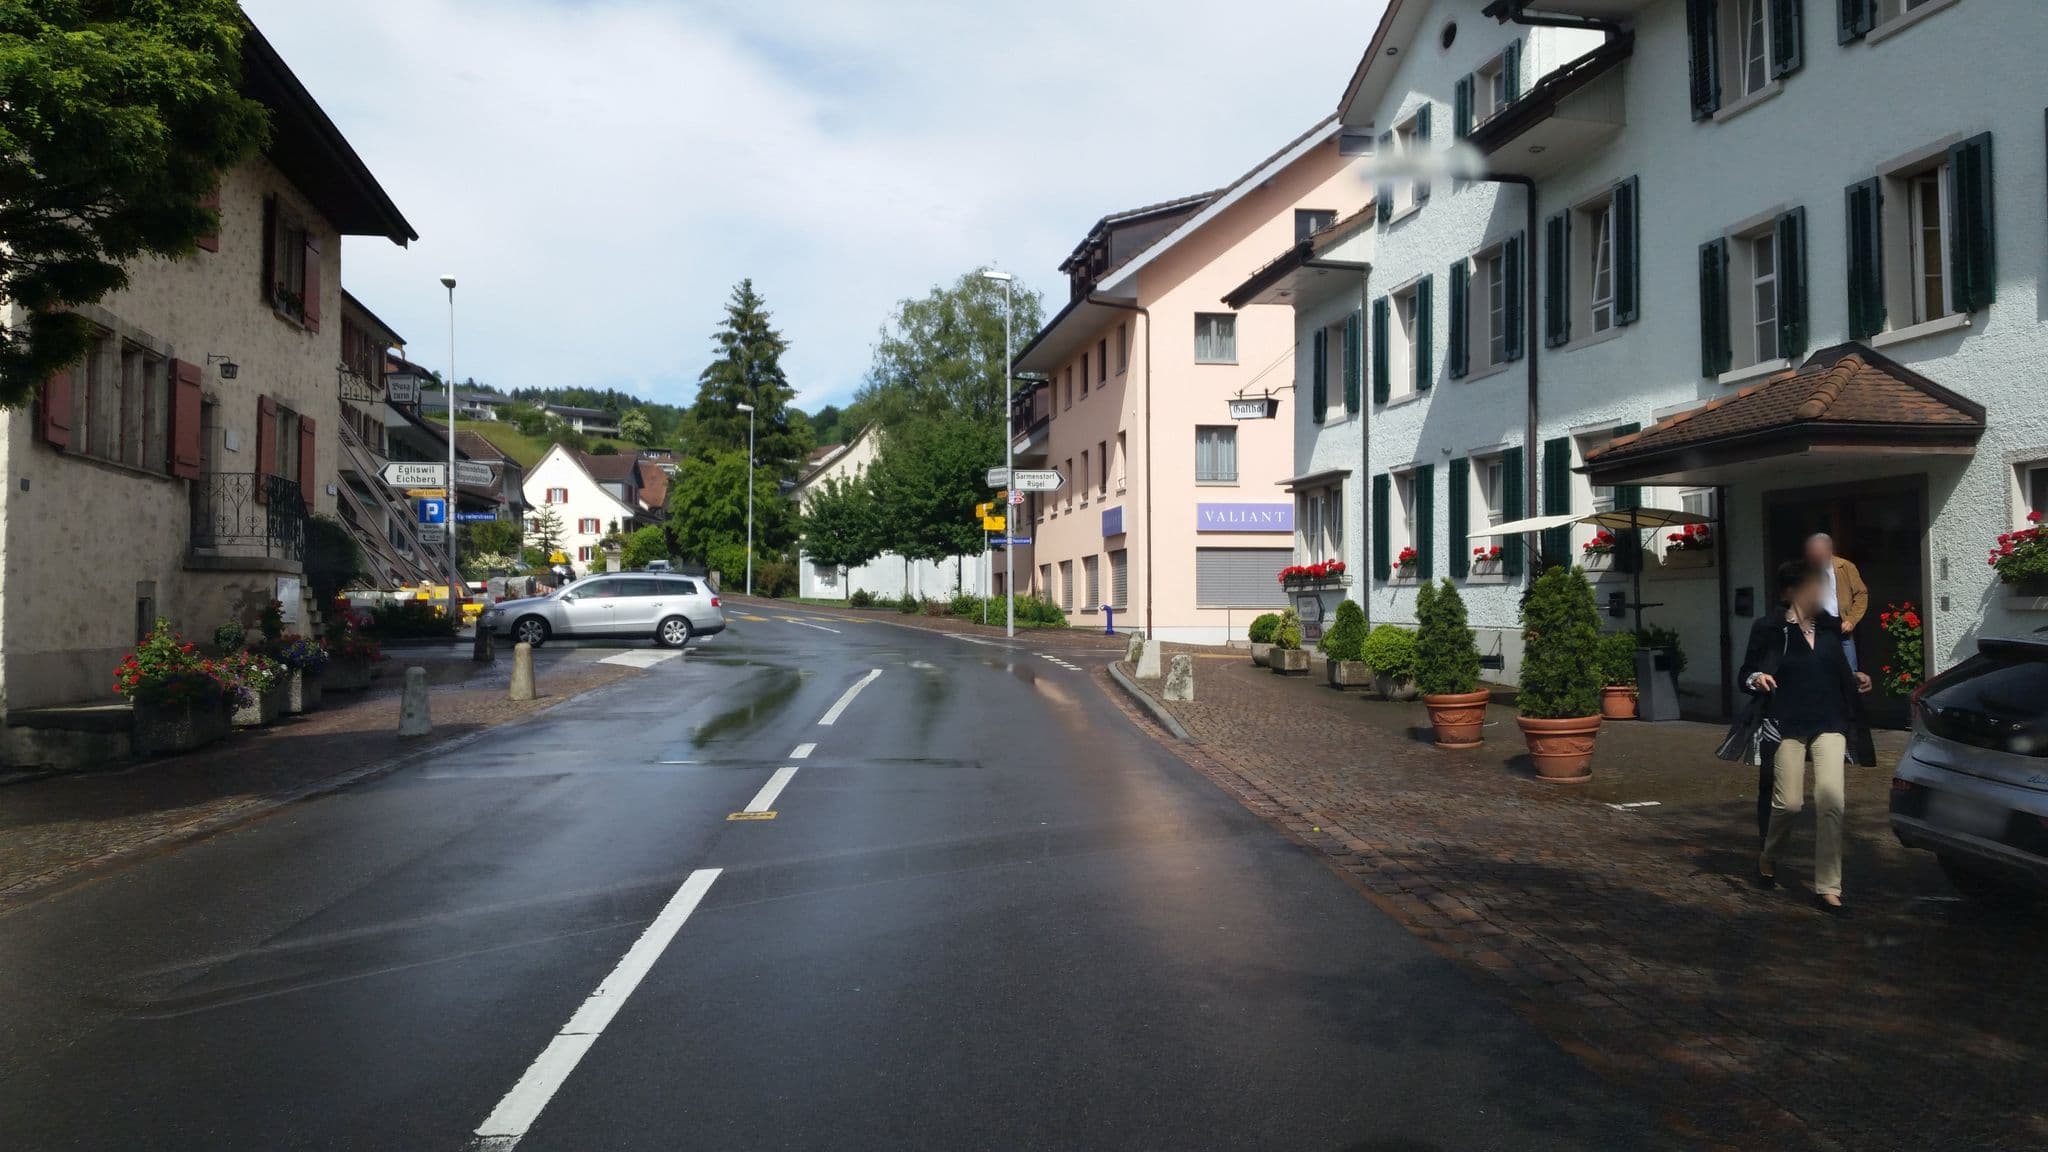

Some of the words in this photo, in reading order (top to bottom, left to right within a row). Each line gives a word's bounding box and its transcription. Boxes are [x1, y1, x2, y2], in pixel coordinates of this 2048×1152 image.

[398, 464, 435, 474] Egliswil
[396, 475, 437, 485] Eichberg
[1026, 480, 1045, 488] Rügel
[425, 502, 439, 520] P
[1204, 511, 1286, 523] VALIANT
